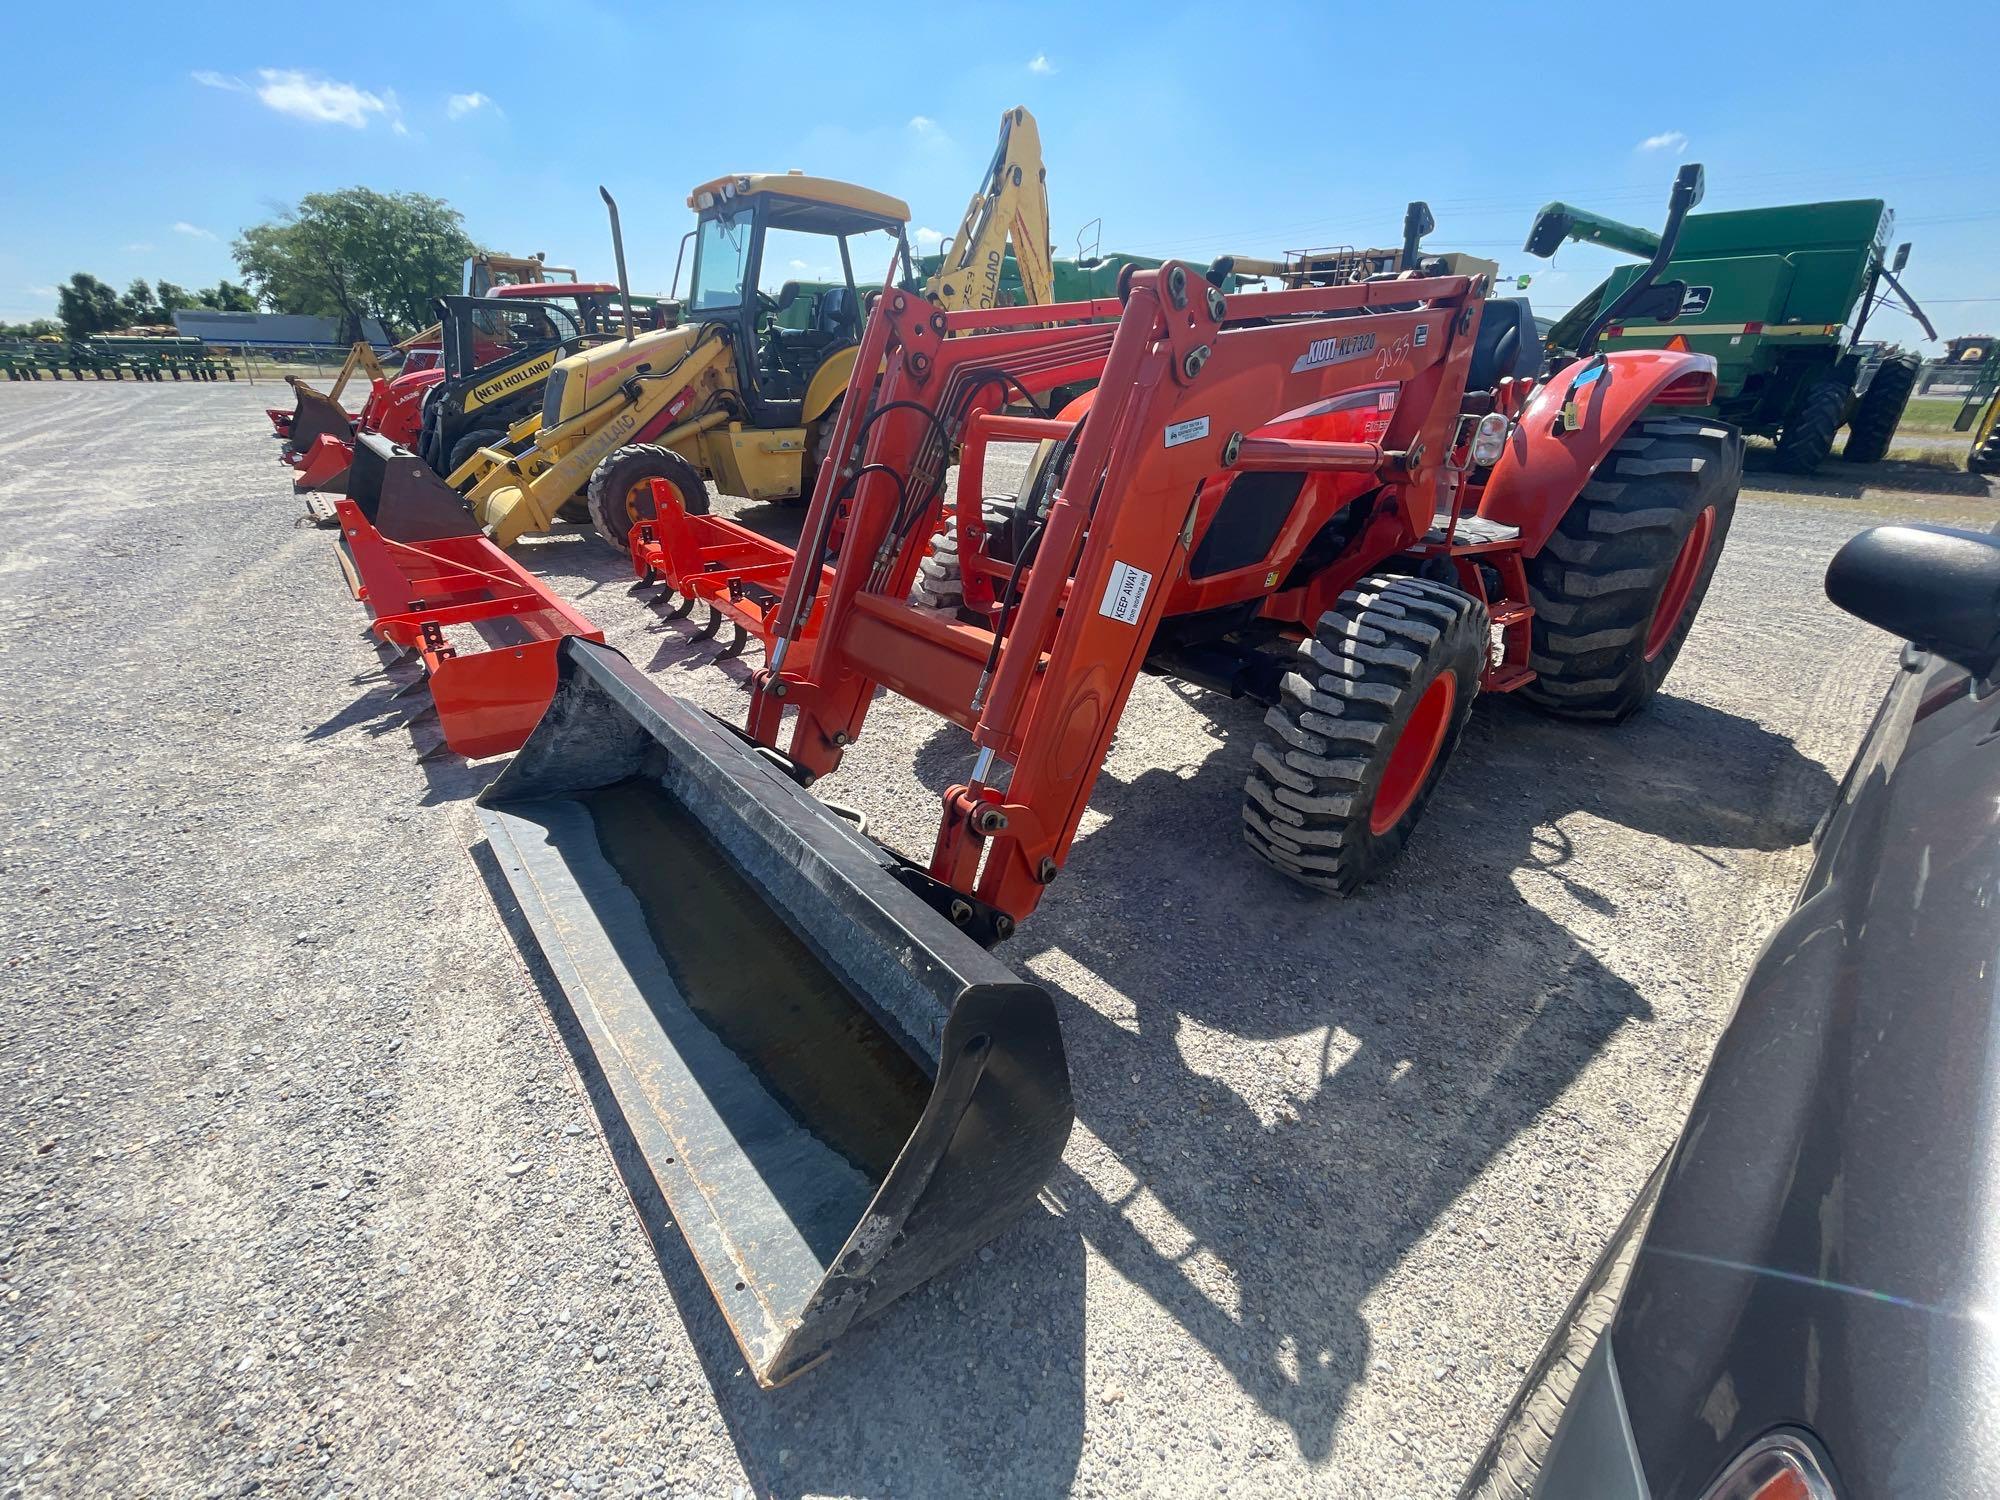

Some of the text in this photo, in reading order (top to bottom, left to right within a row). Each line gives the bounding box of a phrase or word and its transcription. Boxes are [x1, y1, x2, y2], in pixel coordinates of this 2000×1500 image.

[980, 250, 1000, 309] OLLAND
[1307, 332, 1377, 364] KIOTI KL7320
[477, 360, 550, 399] NEW HOLLAND
[1378, 392, 1395, 411] KIOTI
[1114, 569, 1138, 618] KEEP AWAY
[1127, 608, 1137, 621] from
[1133, 586, 1145, 608] working
